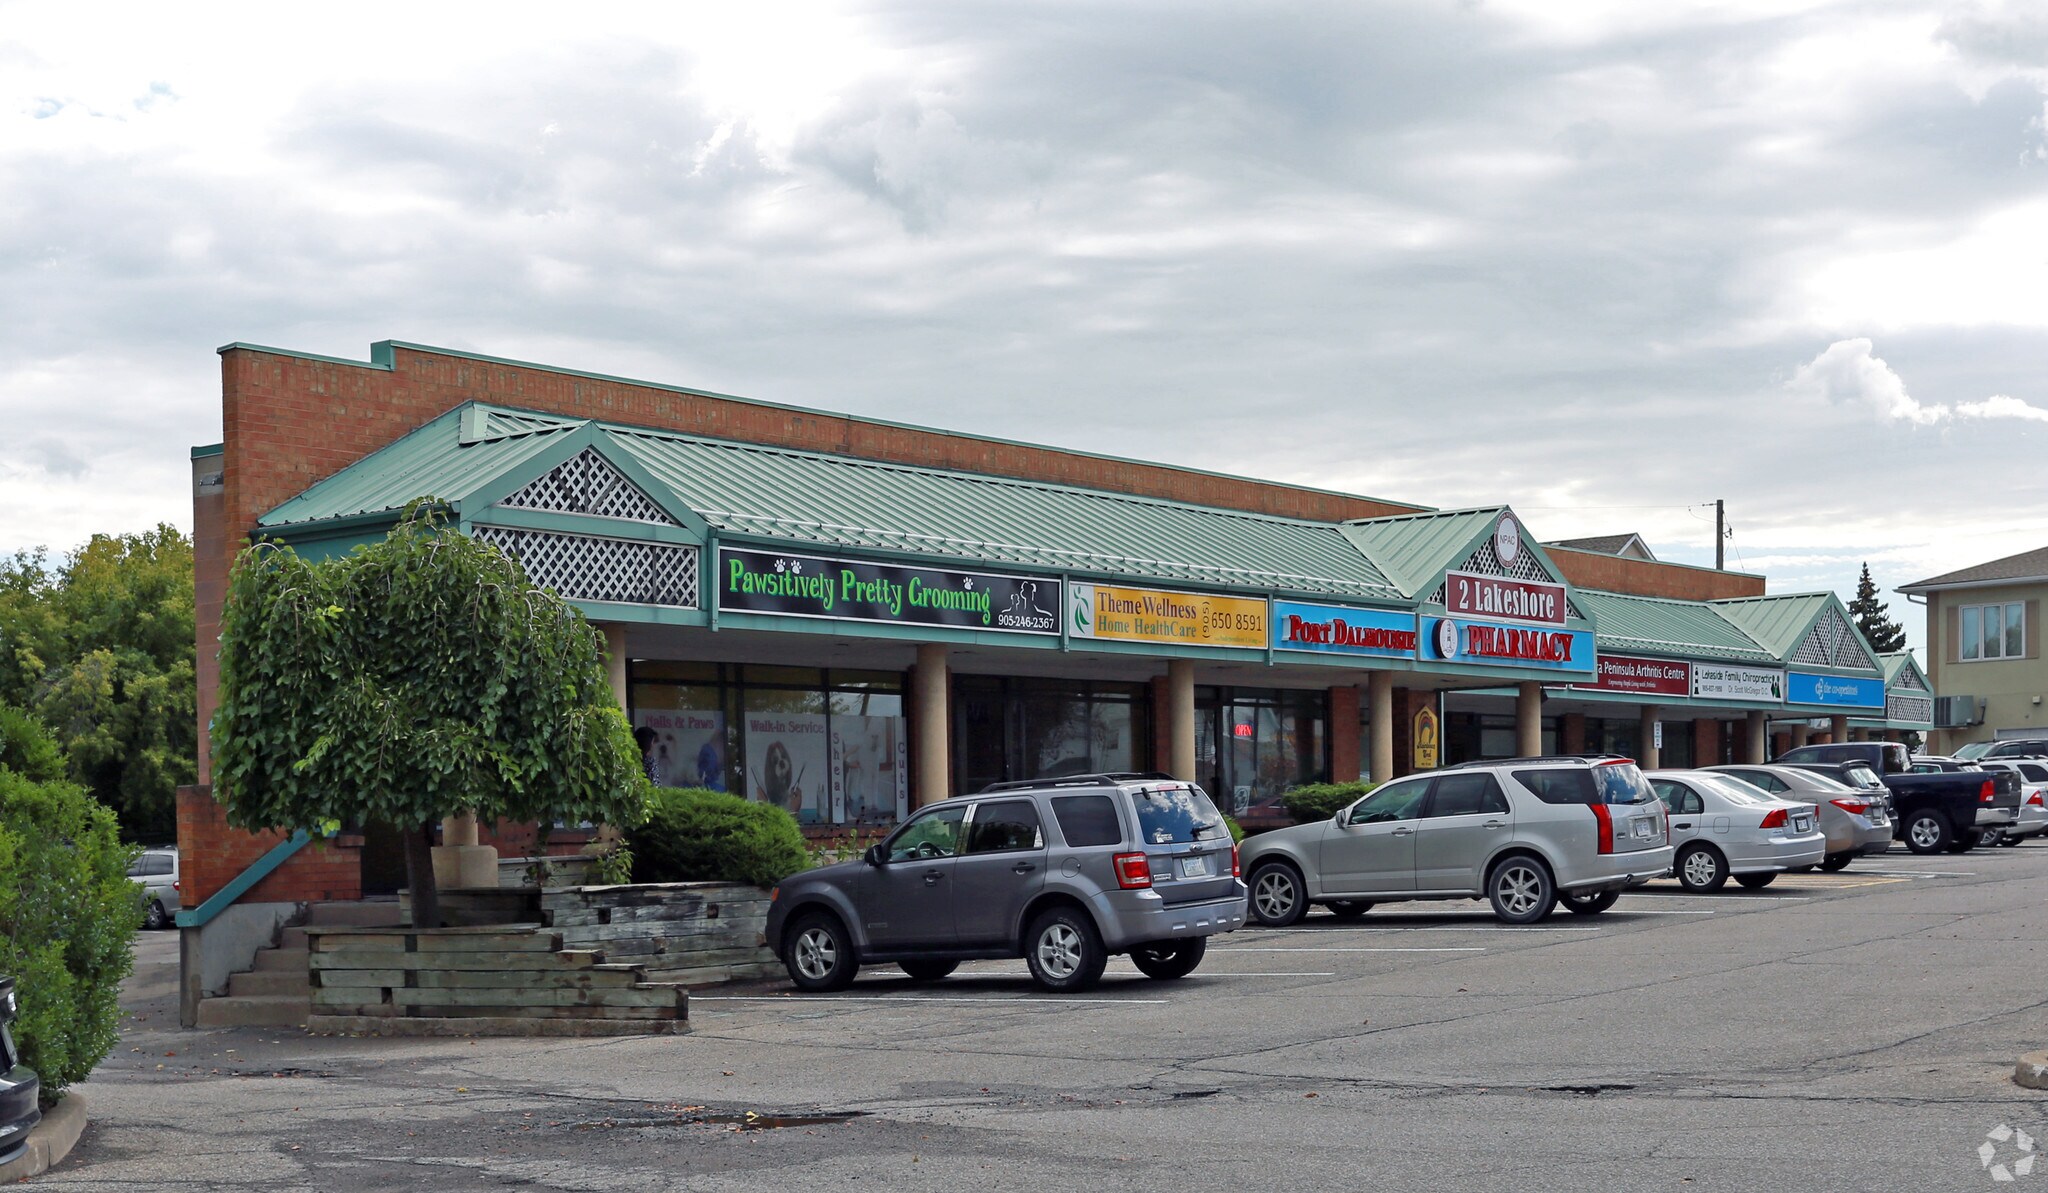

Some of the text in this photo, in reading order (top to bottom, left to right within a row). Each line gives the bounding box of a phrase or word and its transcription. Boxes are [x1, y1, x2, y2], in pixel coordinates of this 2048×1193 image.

[728, 558, 991, 625] Pawsitively Pretty Grooming
[1459, 579, 1555, 619] 2 Lakeshore
[998, 614, 1055, 629] 905-246-2367
[1098, 615, 1197, 638] Home HealthCare
[1202, 601, 1211, 639] (905)
[1211, 611, 1262, 631] 650 8591
[1467, 625, 1574, 661] PHARMACY
[1604, 661, 1635, 677] Peninsula
[1636, 664, 1662, 679] Arthritis
[1663, 666, 1685, 680] Centre
[1701, 669, 1772, 685] Lakeside Family Chiropractic
[688, 715, 714, 729] Paws
[750, 719, 825, 734] Walk-in Service
[1234, 724, 1253, 736] OPEN
